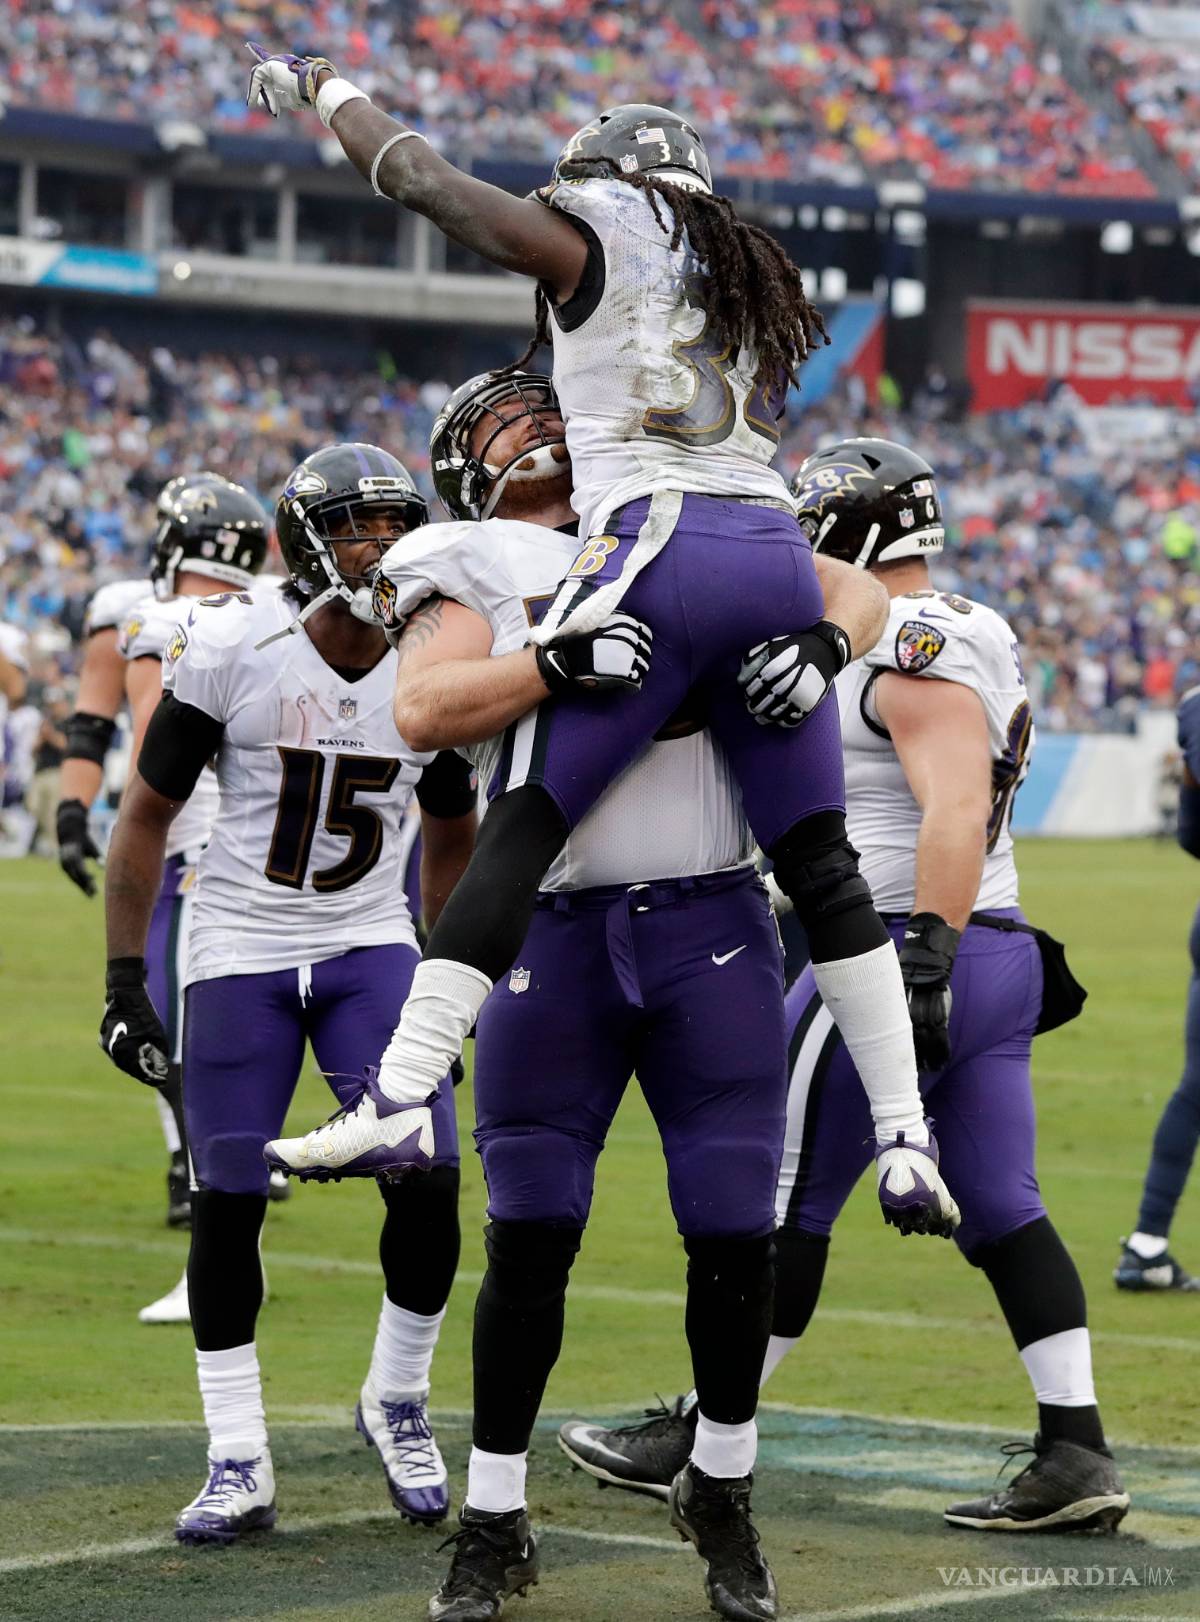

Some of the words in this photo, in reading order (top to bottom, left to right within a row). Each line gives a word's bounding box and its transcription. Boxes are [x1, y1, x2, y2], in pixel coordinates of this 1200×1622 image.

[986, 318, 1200, 380] NISS
[567, 534, 620, 578] B
[905, 621, 944, 642] RAVENS
[316, 738, 365, 748] RAVENS
[264, 746, 402, 893] 15
